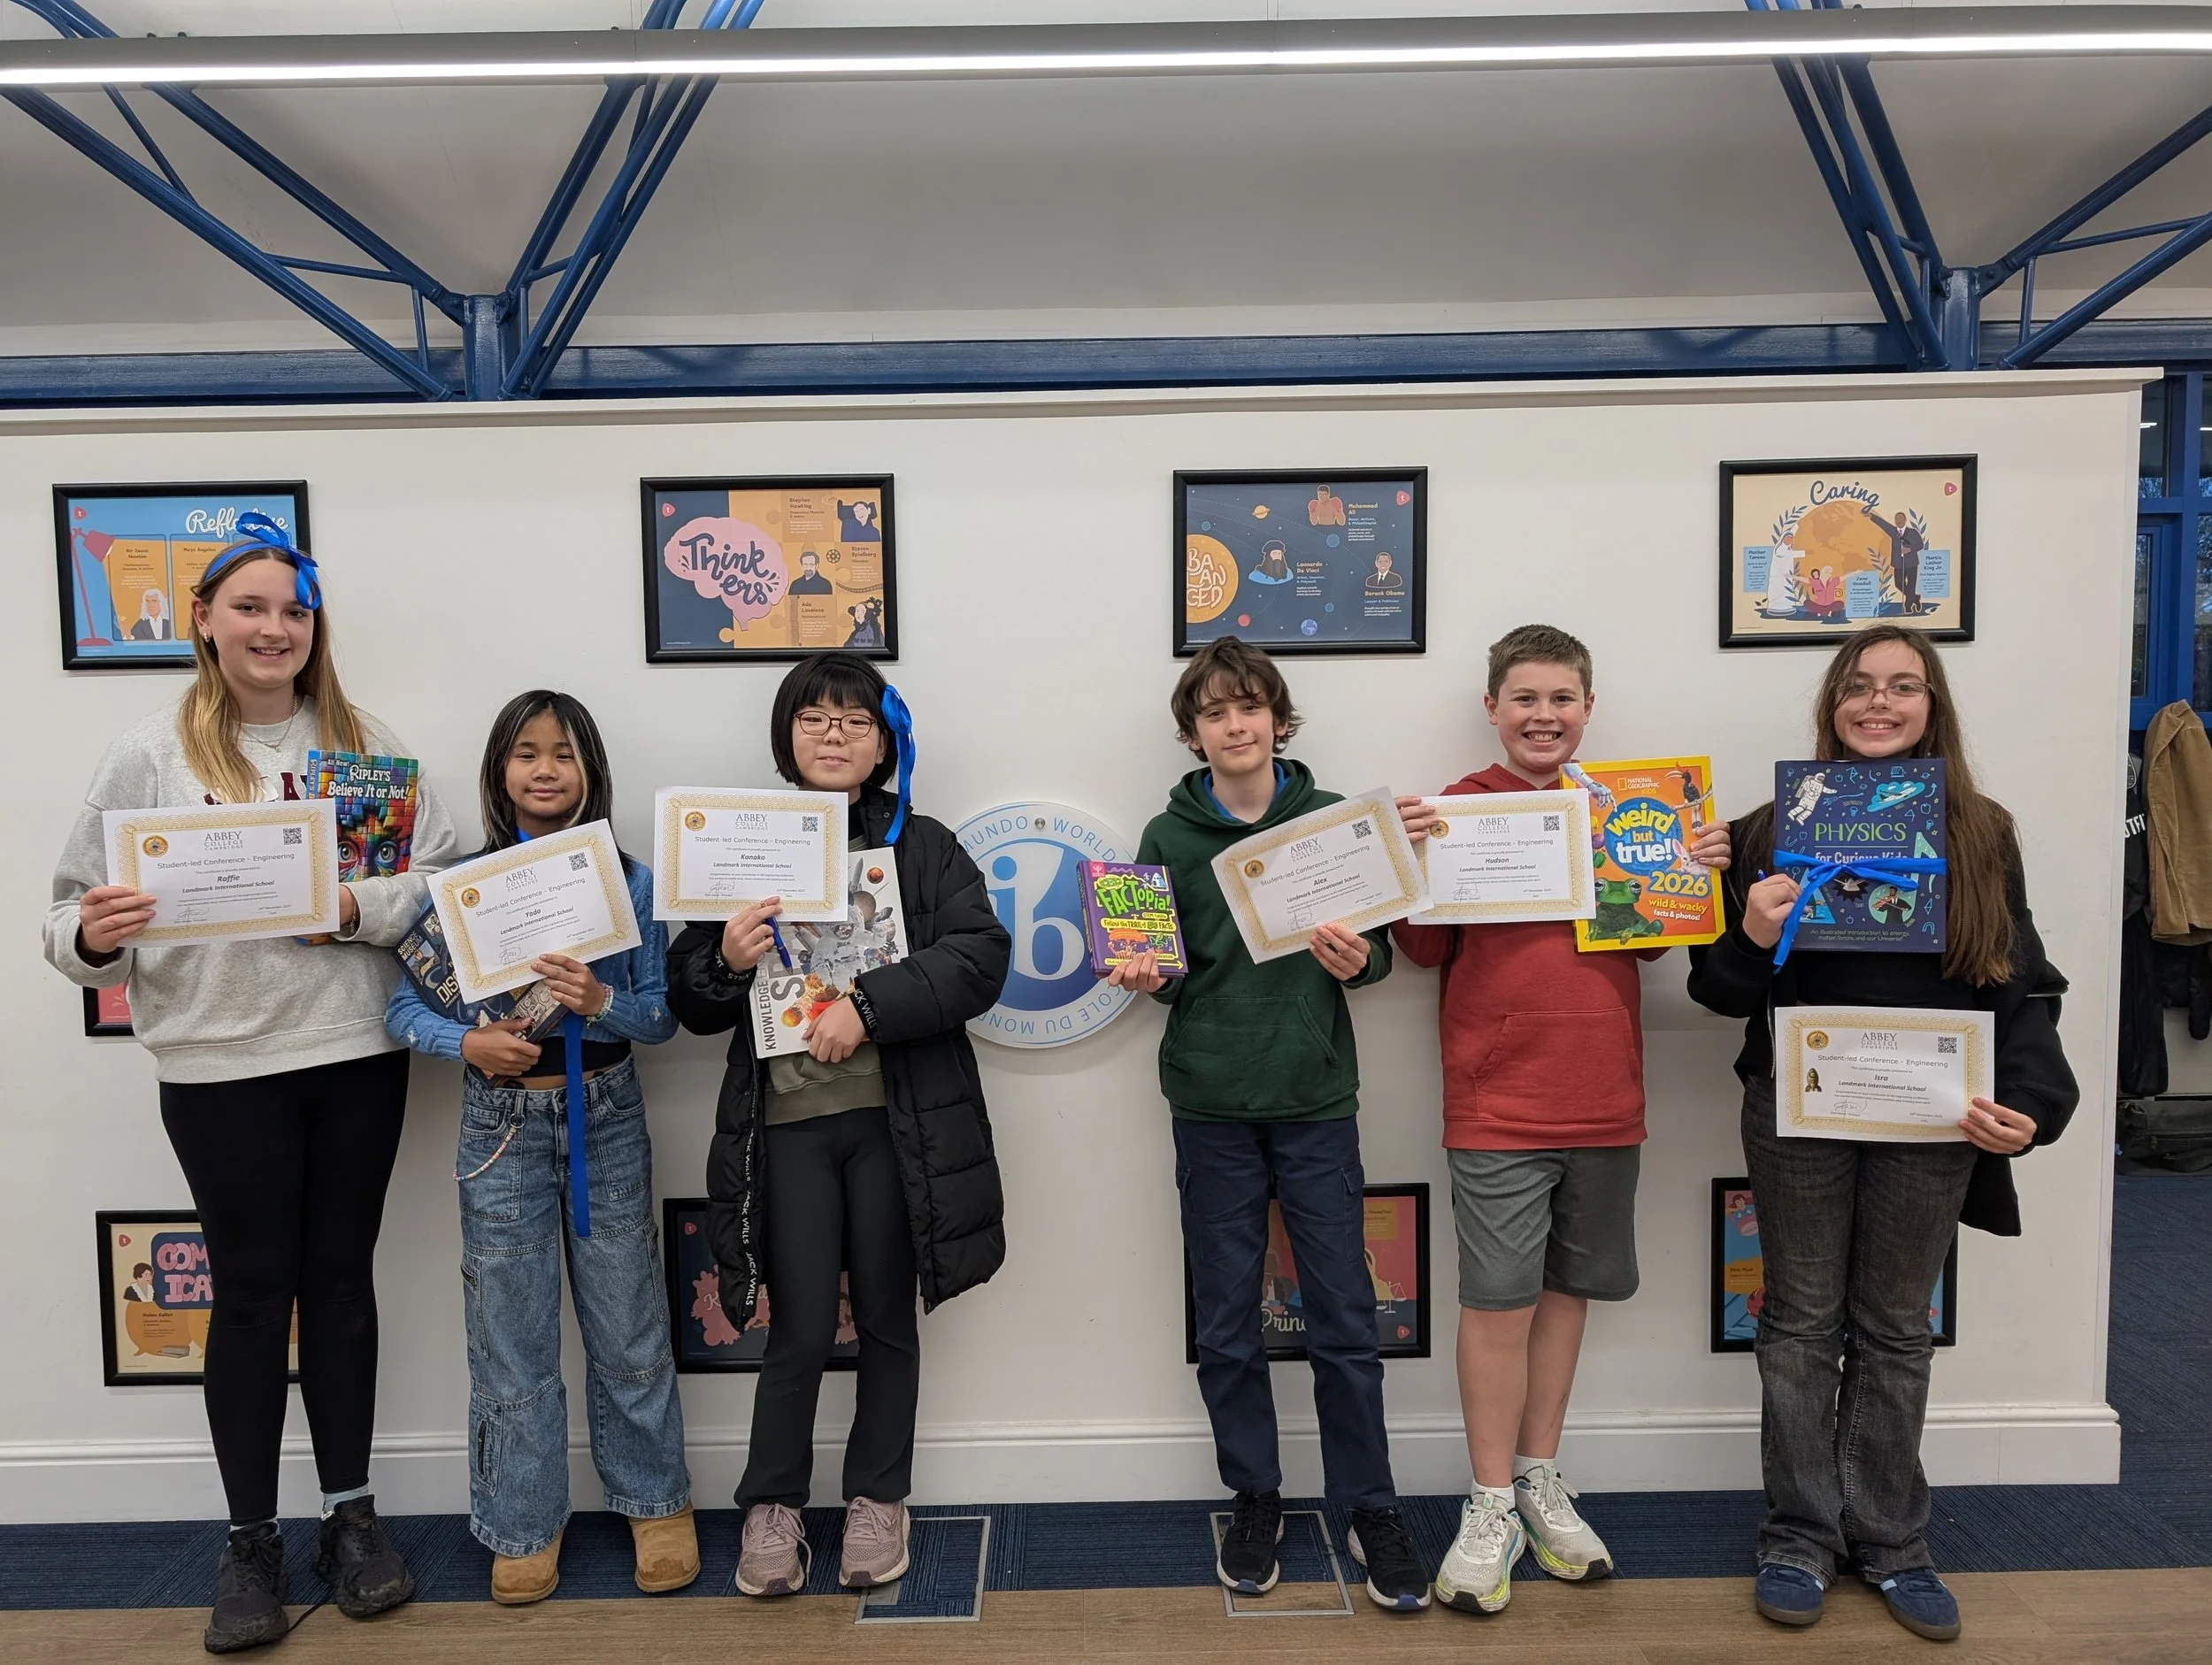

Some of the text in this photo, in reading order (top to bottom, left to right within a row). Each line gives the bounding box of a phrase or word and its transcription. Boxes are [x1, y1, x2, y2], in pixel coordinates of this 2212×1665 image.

[1810, 480, 1879, 513] Caring
[680, 533, 770, 580] Think
[349, 764, 391, 782] RIPLEY'S
[327, 781, 410, 800] Believe It or Not!
[1479, 817, 1509, 826] ABBEY
[1606, 802, 1676, 837] weird
[204, 832, 242, 841] ABBEY
[1053, 817, 1117, 862] WORLD
[1632, 829, 1654, 842] but
[1816, 823, 1907, 842] PHYSICS
[1290, 837, 1319, 855] ABBEY
[1291, 845, 1323, 858] COLLEGE
[1616, 838, 1673, 863] true!
[157, 853, 295, 870] Student-led Conference Engineering
[1261, 845, 1371, 886] Student-led Conference Engineering
[1292, 849, 1324, 863] CAMBRIDGE
[505, 867, 534, 884] ABBEY
[505, 874, 537, 888] COLLEGE
[1651, 871, 1709, 897] 2026
[507, 879, 539, 892] CAMBRIDGE
[1286, 873, 1360, 903] Landmark International School
[476, 877, 586, 917] Student-led Conference Engineering
[1648, 897, 1669, 908] wild
[1678, 901, 1708, 914] wacky
[501, 907, 573, 935] Landmark International School
[526, 909, 541, 917] Yada
[1675, 911, 1701, 921] photos!
[397, 931, 418, 955] SCIENCE
[401, 935, 423, 961] MUSEUM
[757, 979, 777, 1050] KNOWLEDGE
[862, 1002, 878, 1028] WILLS
[1046, 1017, 1071, 1034] DU
[1862, 1032, 1897, 1041] ABBEY
[741, 1190, 751, 1215] JACK
[745, 1252, 757, 1306] JACK WILLS
